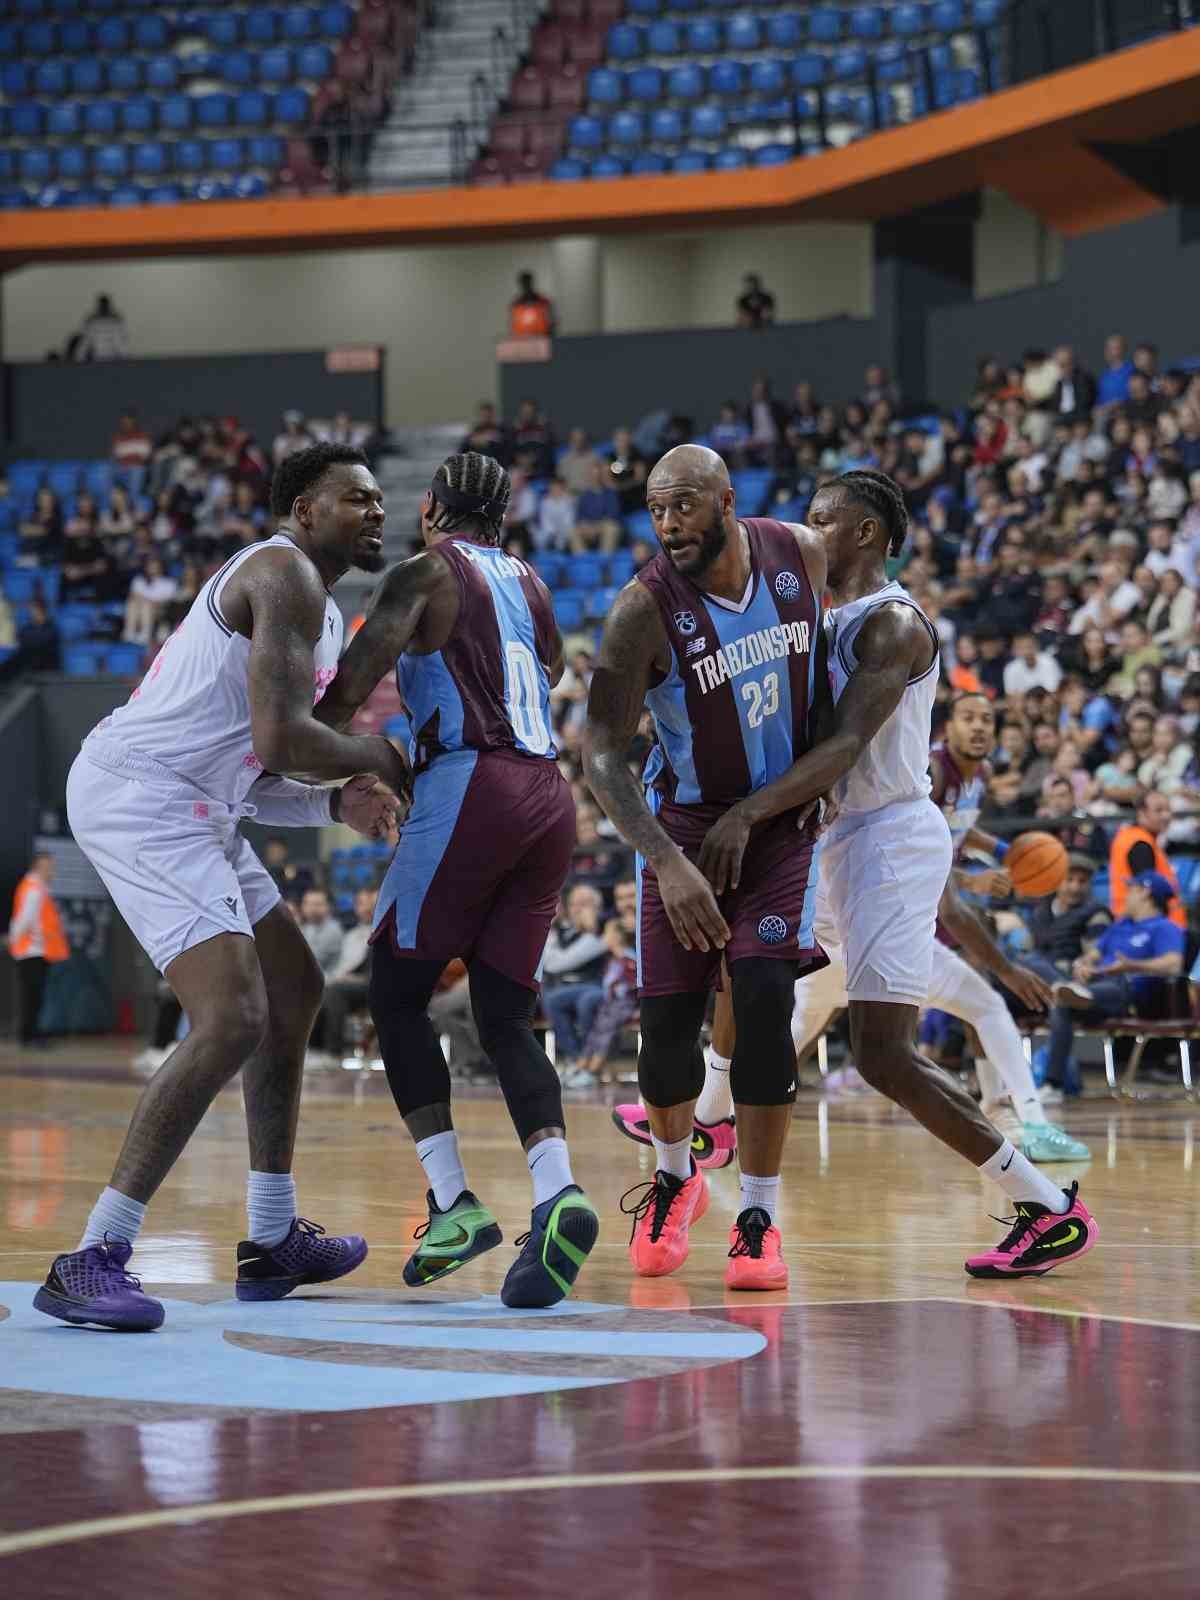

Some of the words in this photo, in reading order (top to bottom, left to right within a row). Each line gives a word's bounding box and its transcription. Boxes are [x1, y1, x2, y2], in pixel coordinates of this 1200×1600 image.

[692, 621, 810, 695] TRABZONSPOR
[507, 642, 550, 754] 0
[741, 671, 779, 729] 23
